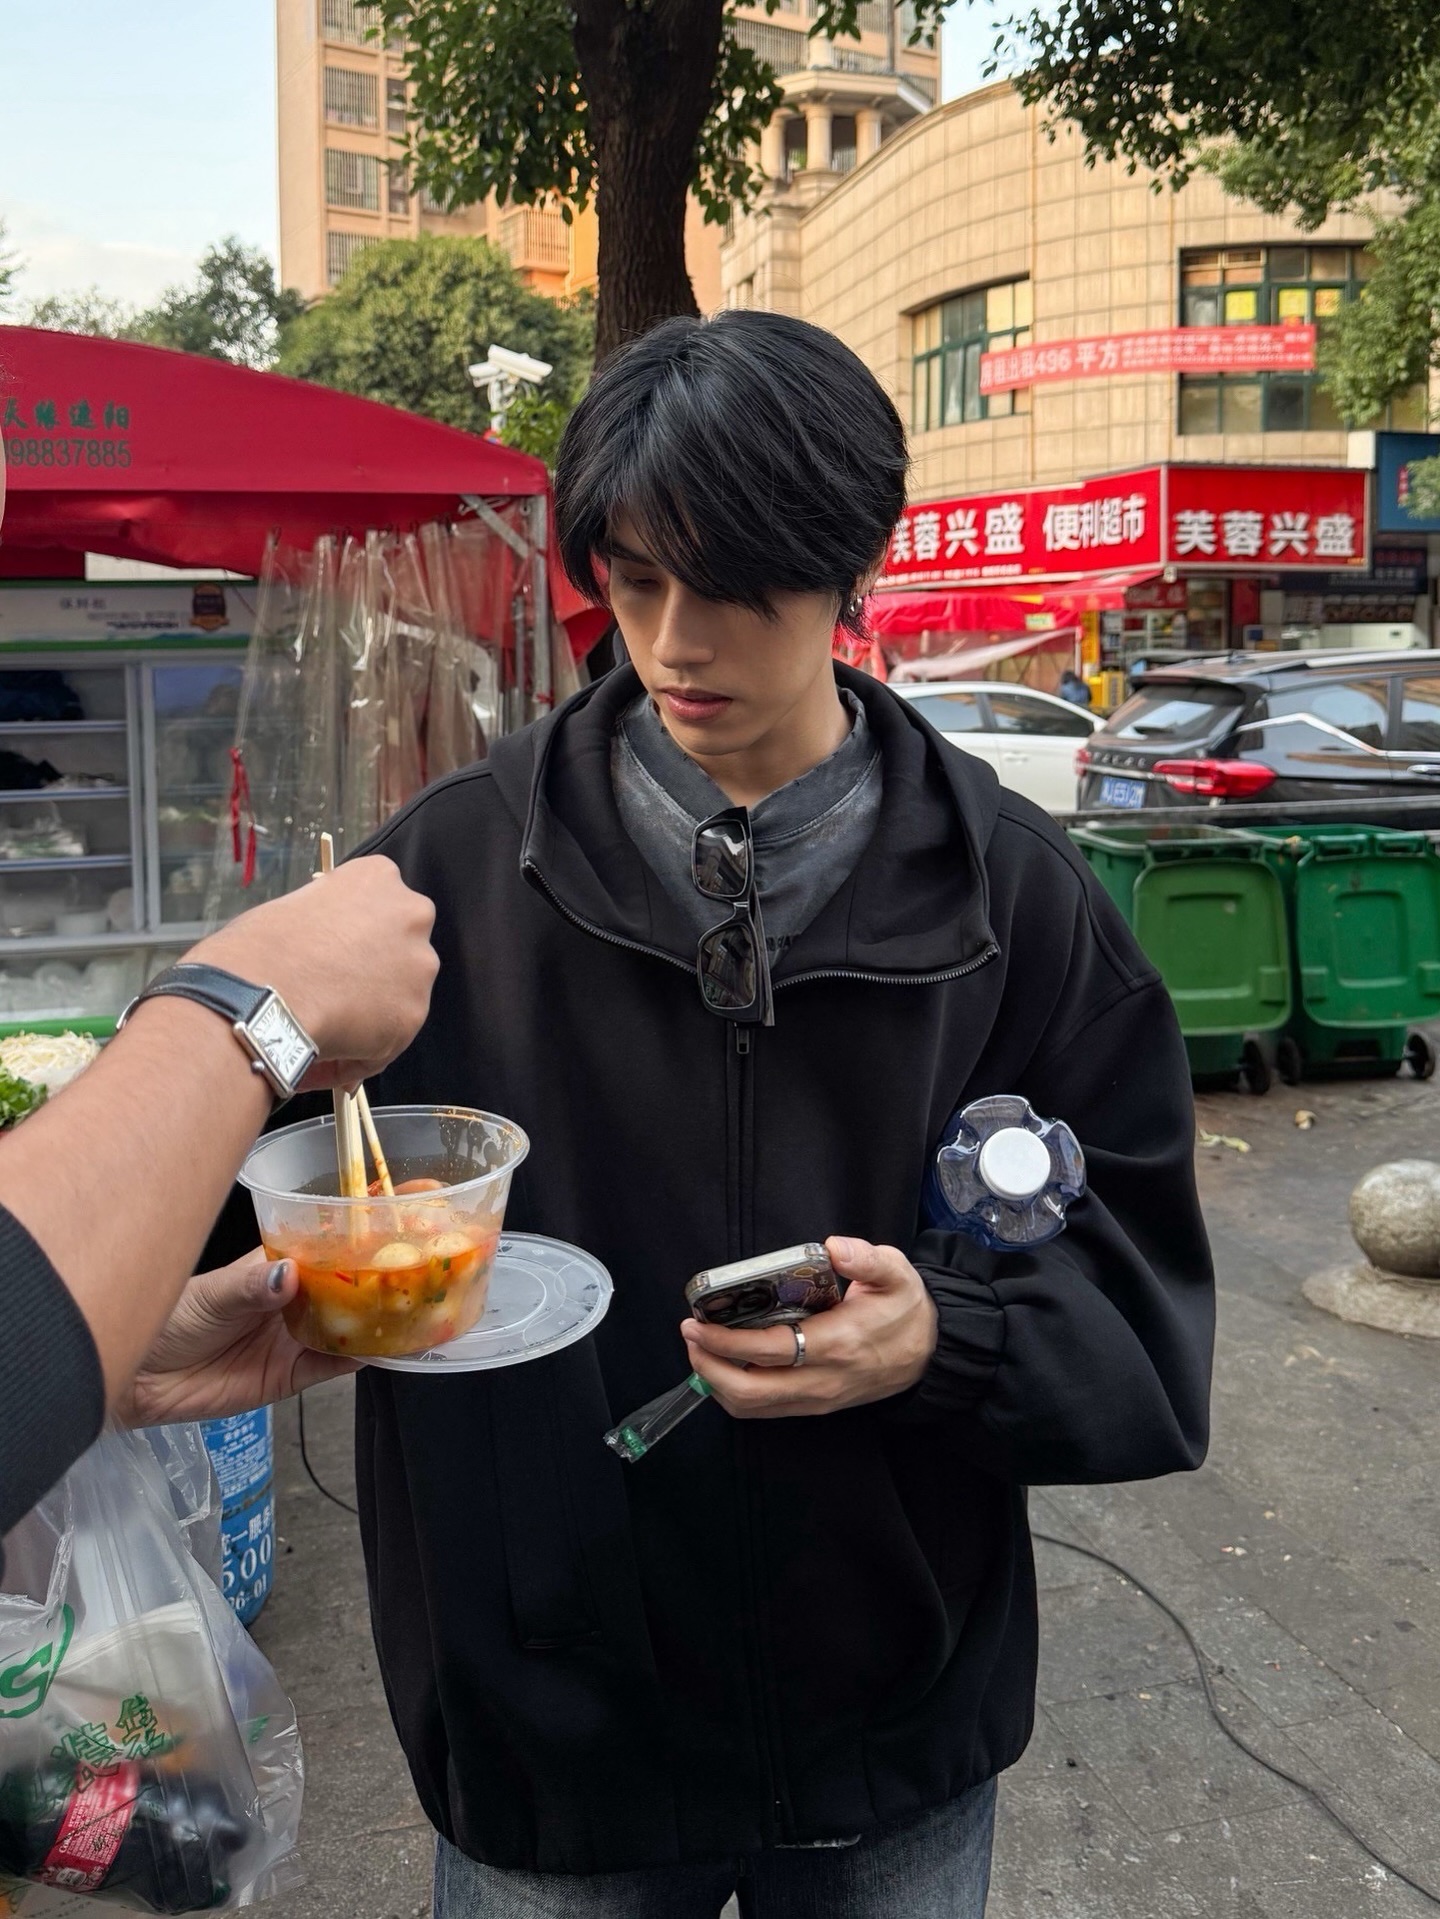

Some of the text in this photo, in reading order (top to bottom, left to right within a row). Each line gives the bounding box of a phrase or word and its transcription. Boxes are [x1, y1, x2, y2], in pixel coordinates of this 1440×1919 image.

[1075, 339, 1120, 372] 平方
[4, 438, 131, 468] 98837885
[892, 493, 1147, 563] 芙蓉兴盛 便利超市
[1173, 510, 1356, 557] 芙蓉兴盛
